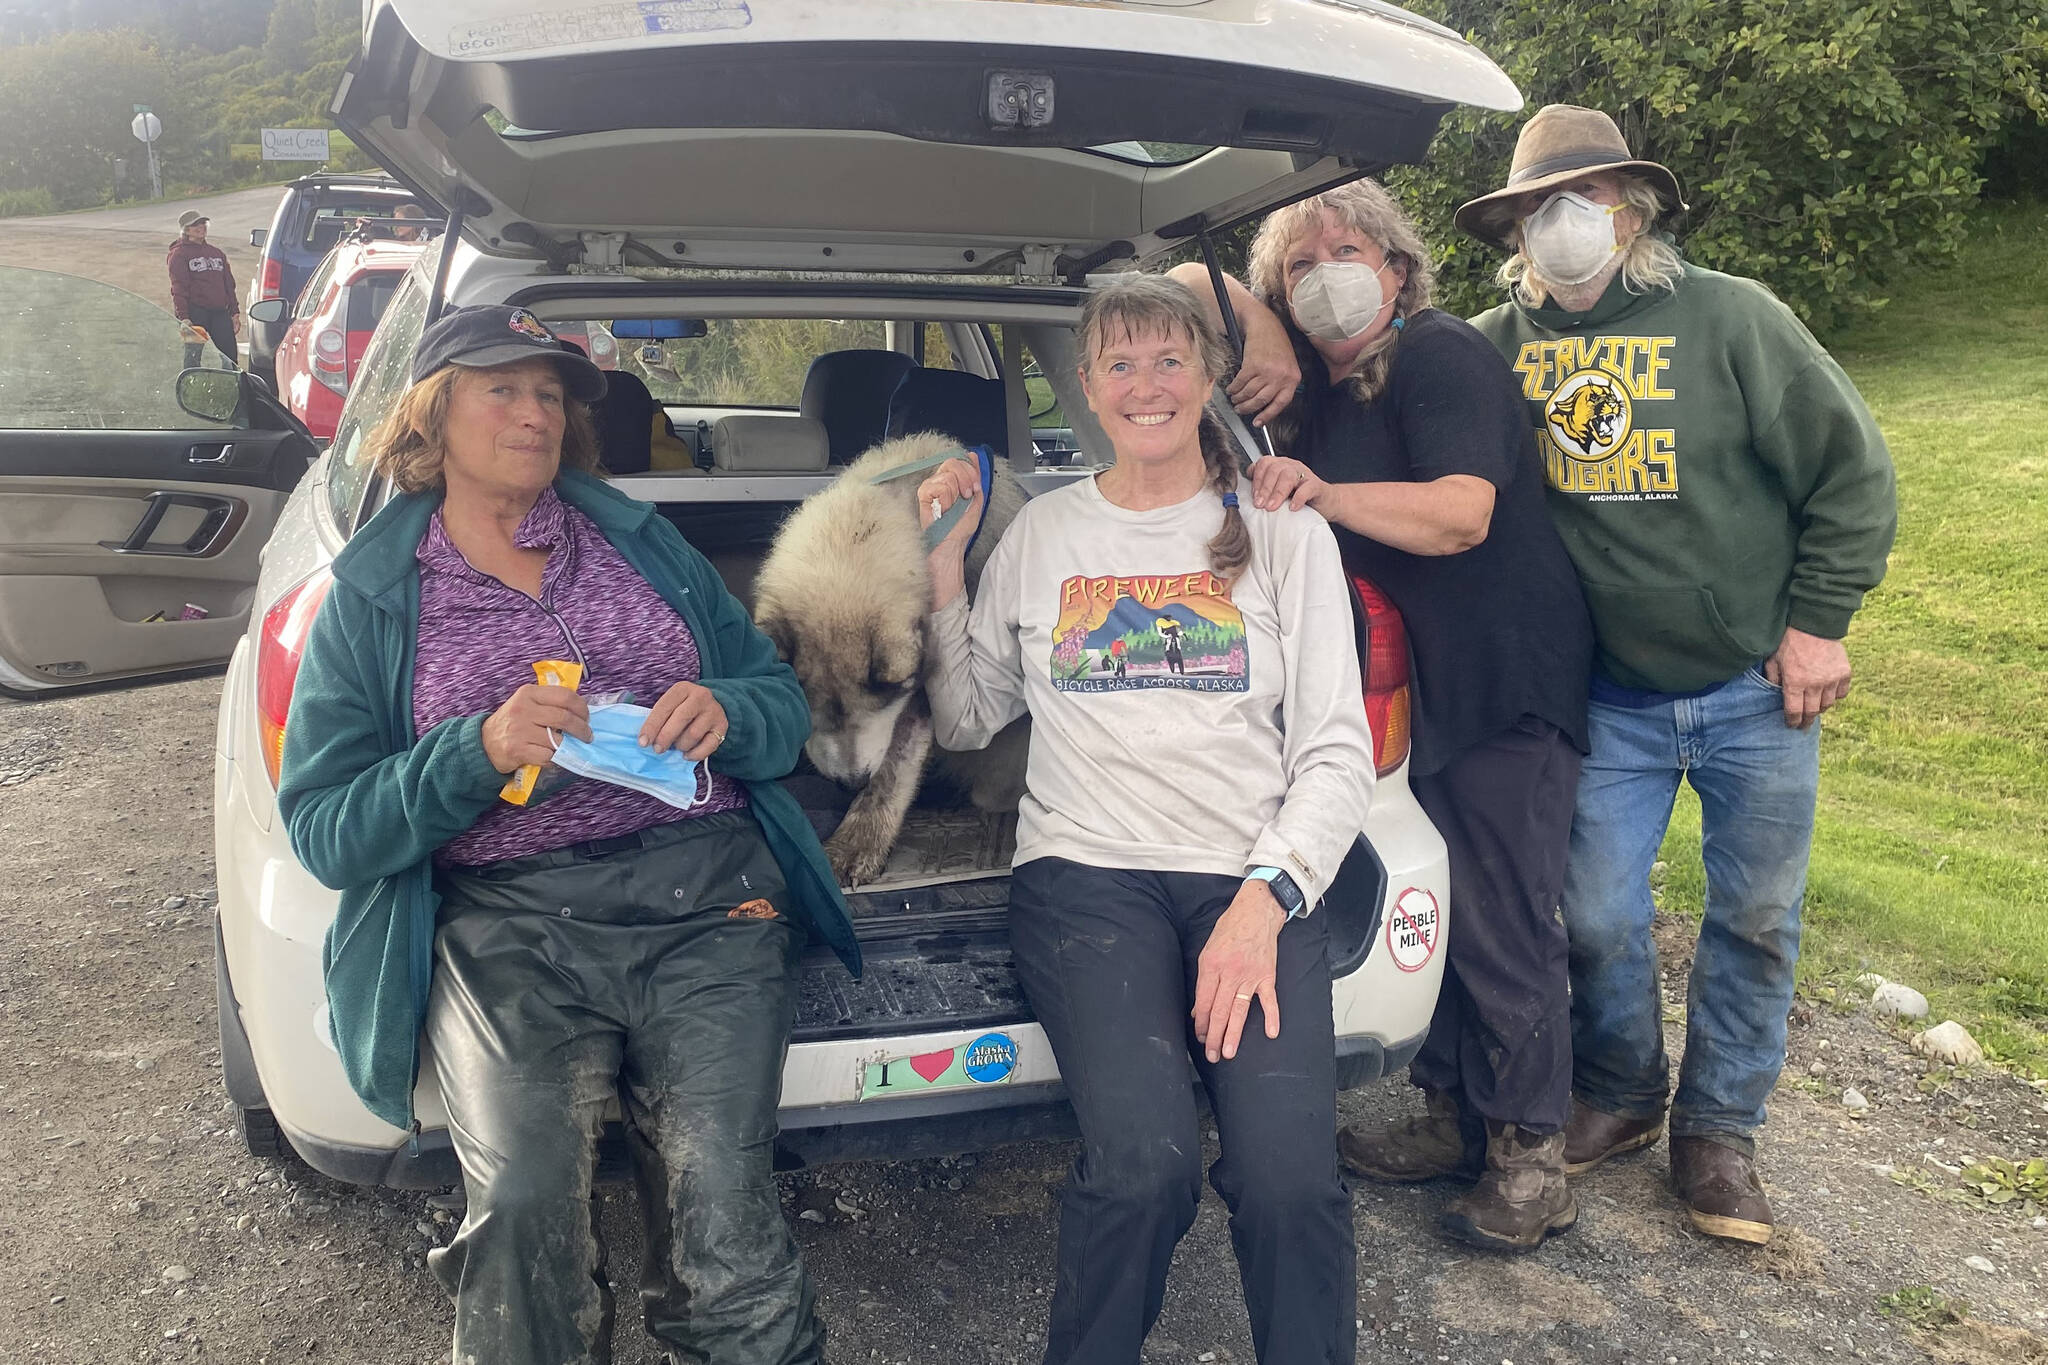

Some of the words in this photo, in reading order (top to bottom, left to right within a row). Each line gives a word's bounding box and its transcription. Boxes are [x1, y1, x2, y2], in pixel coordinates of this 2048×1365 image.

[264, 131, 293, 150] Quiet
[296, 131, 327, 149] Creek
[1513, 336, 1677, 400] SERVICE
[1538, 428, 1679, 492] OUGARS
[1588, 494, 1643, 502] ANCHORAGE,
[1065, 574, 1224, 604] FIREWEED
[1056, 679, 1103, 691] BICYCLE
[1108, 679, 1137, 690] RACE
[1142, 679, 1190, 690] ACROSS
[1196, 679, 1244, 691] ALASKA
[1393, 909, 1435, 932] PEBBLE
[1400, 929, 1431, 949] MINE
[967, 1050, 1013, 1068] GROWN
[974, 1044, 1010, 1055] Alaska
